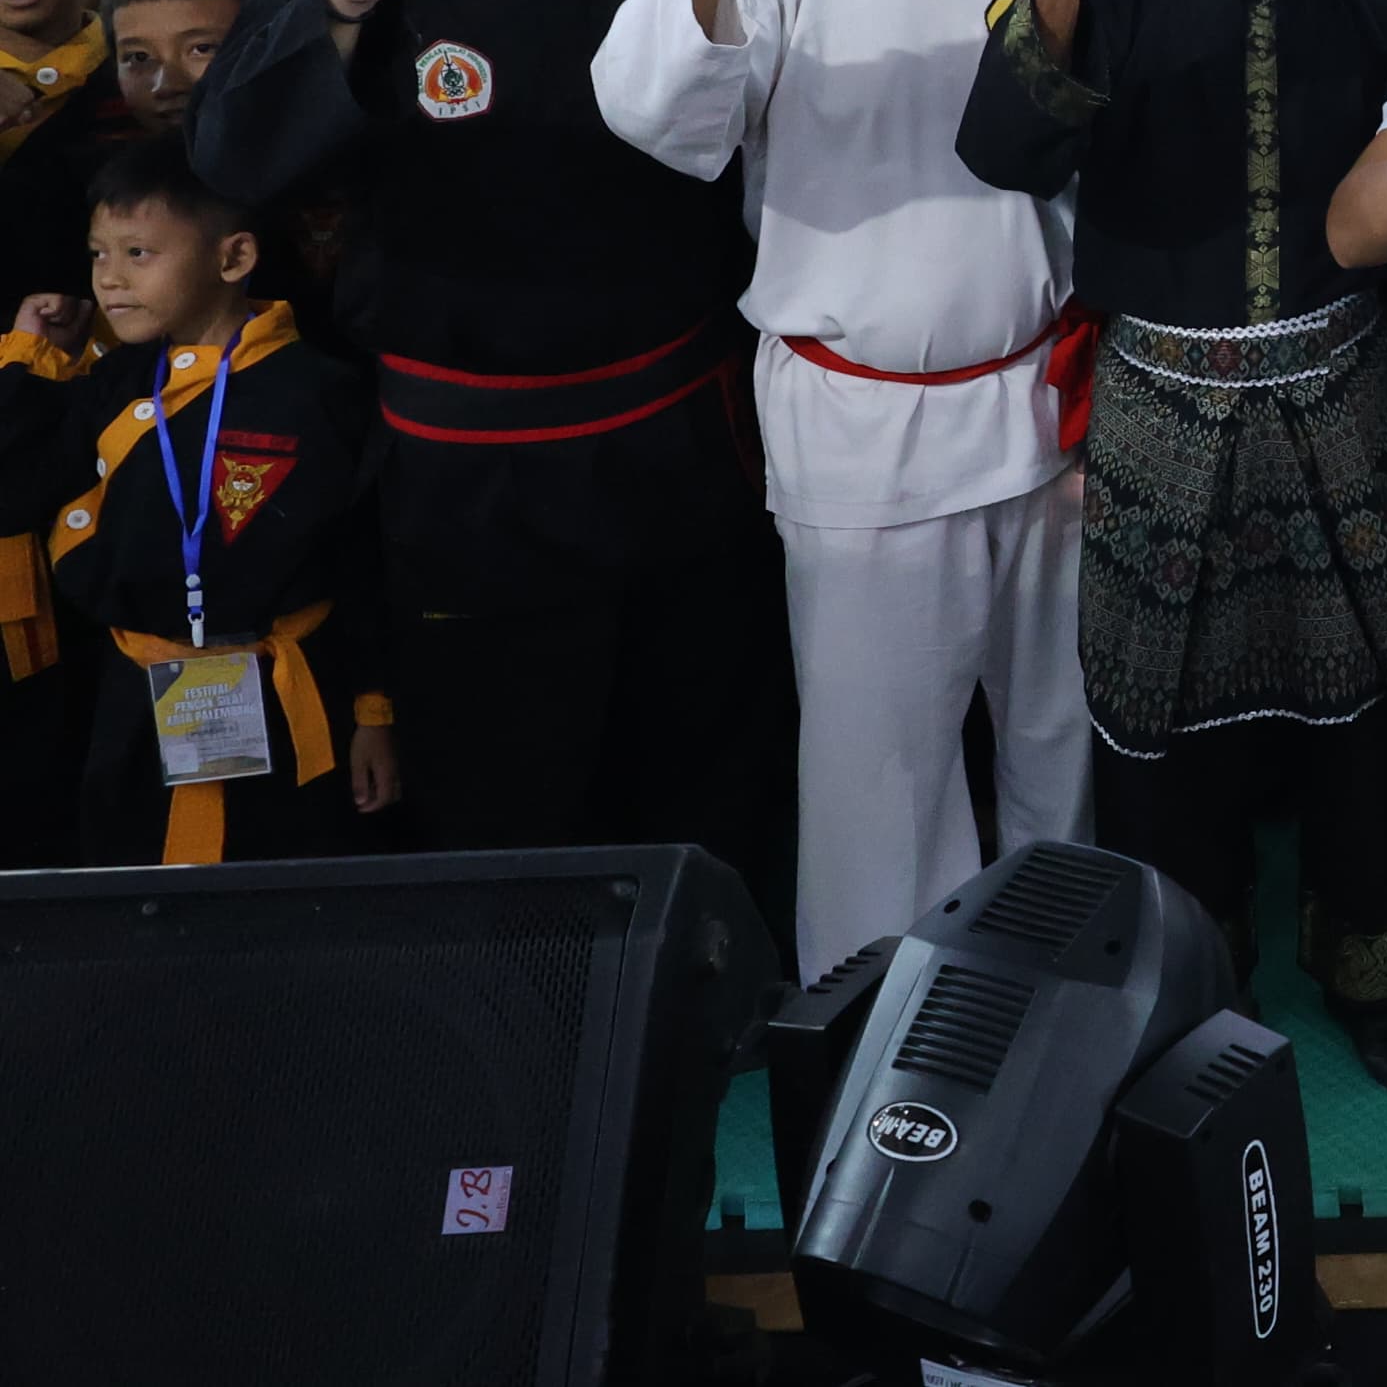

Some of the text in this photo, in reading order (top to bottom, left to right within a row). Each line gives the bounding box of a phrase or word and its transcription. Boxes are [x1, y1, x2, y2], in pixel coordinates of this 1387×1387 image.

[876, 1114, 947, 1149] BEAM
[1249, 1168, 1274, 1314] BEAM 230
